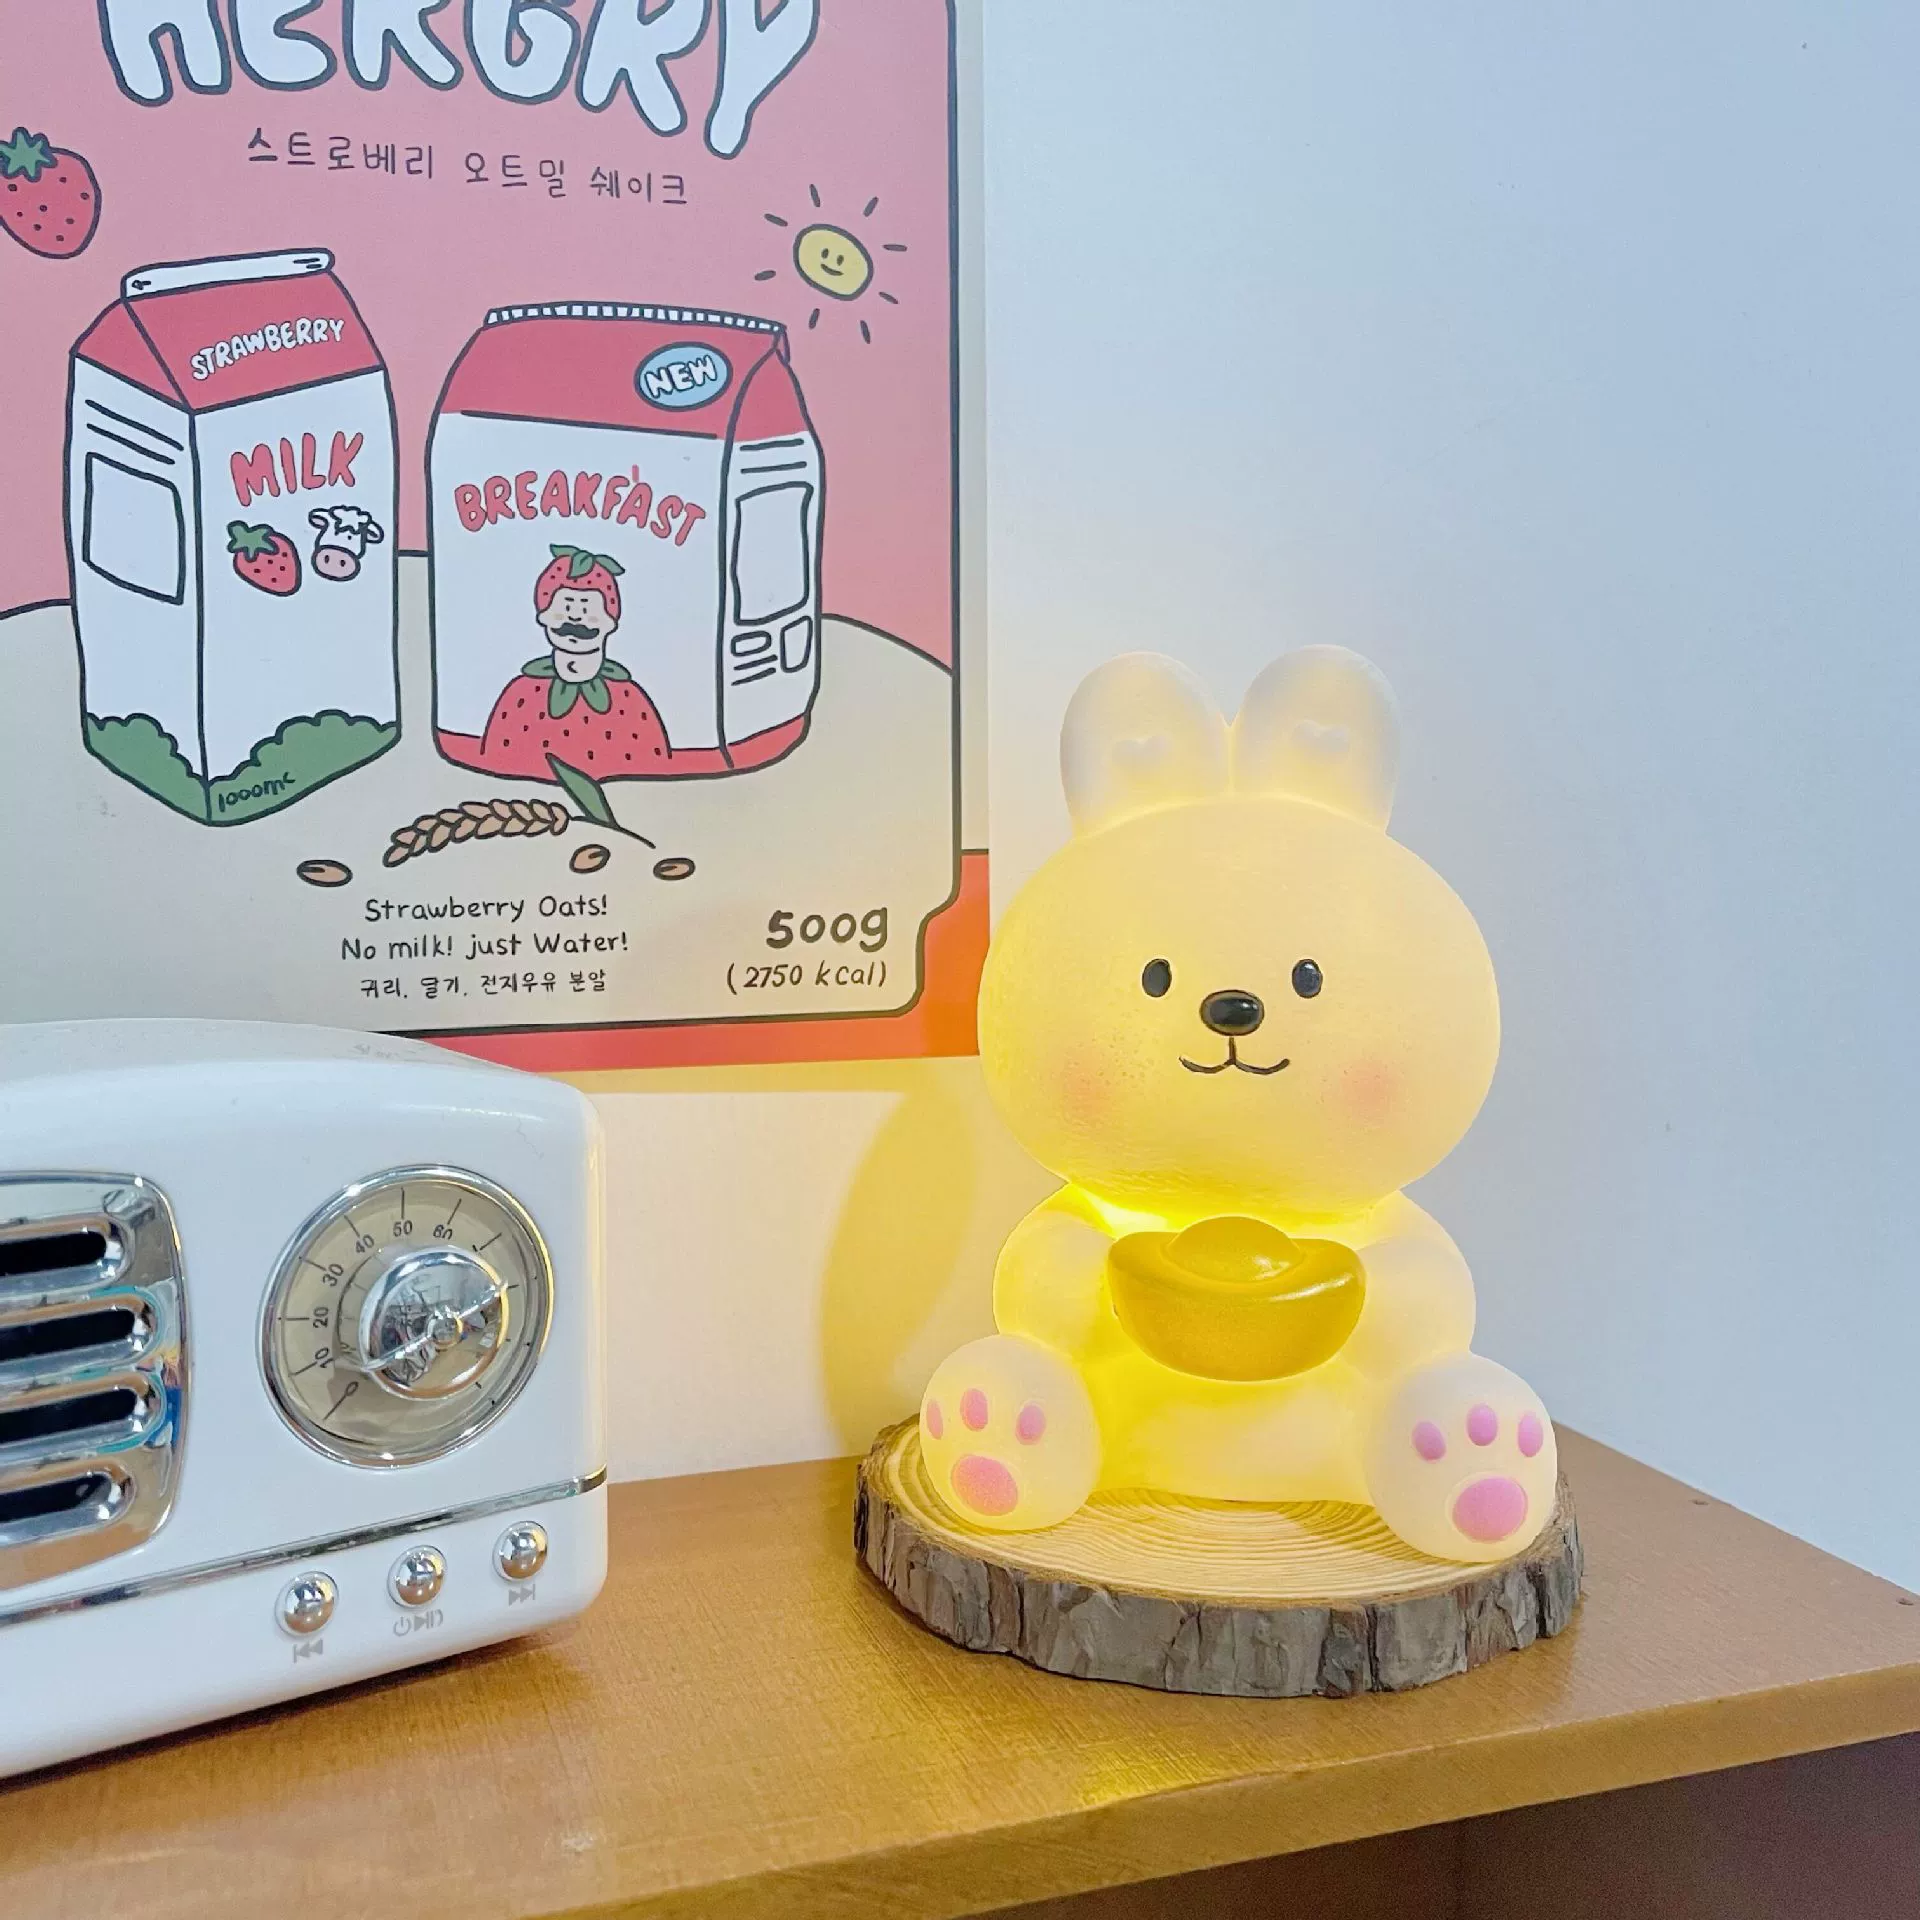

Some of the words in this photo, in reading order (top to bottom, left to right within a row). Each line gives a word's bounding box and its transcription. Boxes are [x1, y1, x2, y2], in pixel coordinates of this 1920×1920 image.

[248, 127, 433, 179] 스트로베리
[465, 152, 567, 199] 오트밀
[590, 166, 688, 205] 쉐이크
[190, 316, 346, 381] STRAWBERRY
[643, 354, 719, 399] NEW
[230, 430, 364, 507] MILK
[454, 468, 706, 546] BREAKFAST
[364, 895, 525, 922] Strawberry
[538, 894, 608, 917] Oats!
[766, 906, 889, 953] 500g
[341, 937, 376, 960] No
[388, 934, 453, 960] milk!
[465, 933, 522, 960] just
[533, 931, 629, 953] Water!
[393, 1220, 413, 1238] 50
[355, 1233, 375, 1255] 40
[322, 1263, 344, 1288] 30
[312, 1306, 330, 1329] 20
[314, 1347, 334, 1369] 10
